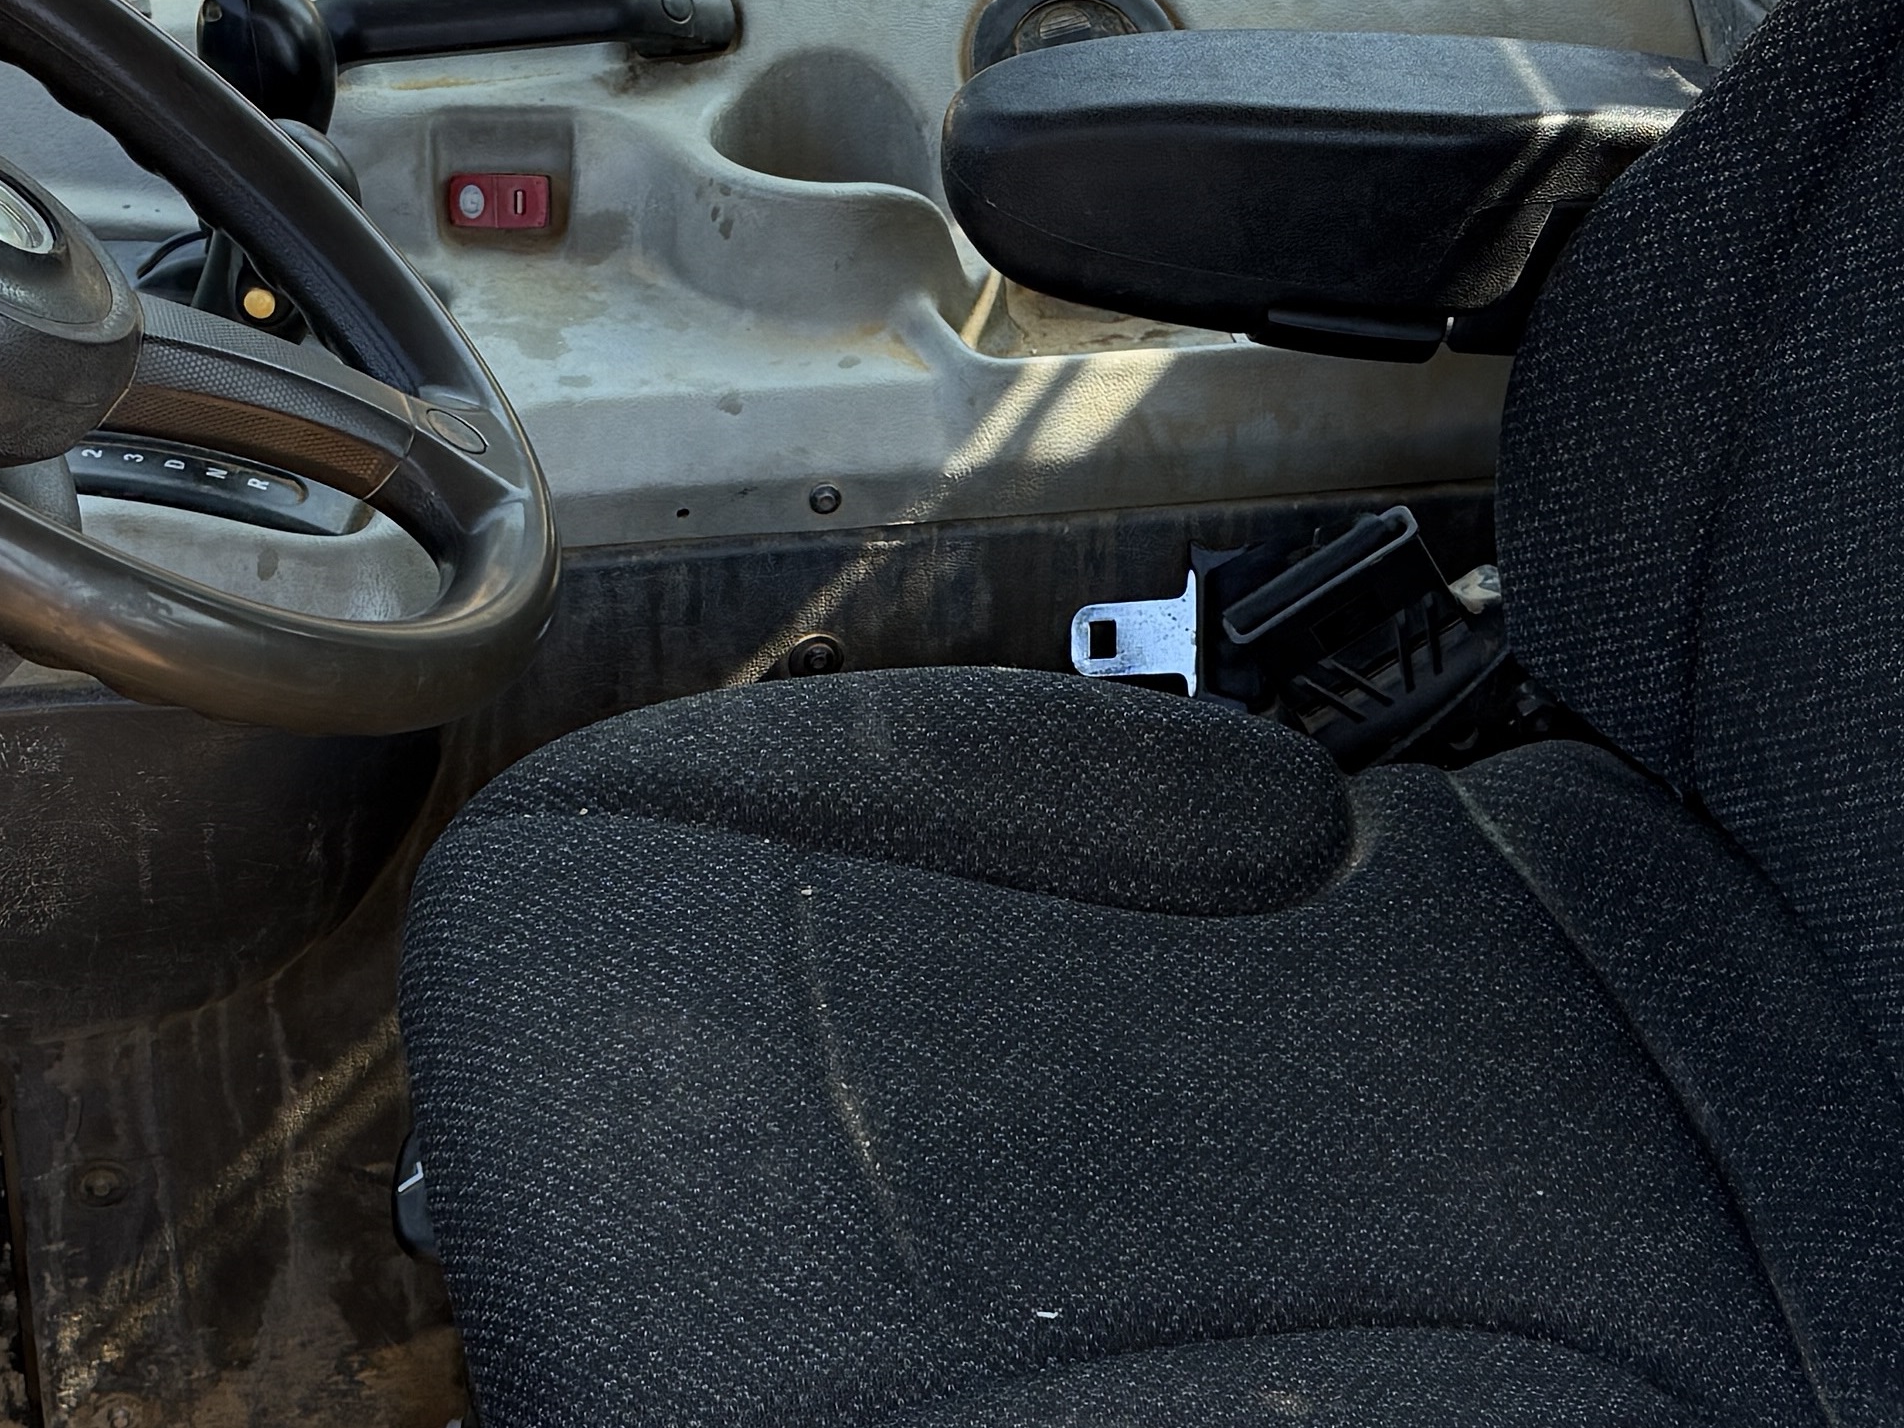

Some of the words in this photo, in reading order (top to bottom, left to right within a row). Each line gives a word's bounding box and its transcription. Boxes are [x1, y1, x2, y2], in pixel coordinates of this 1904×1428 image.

[81, 448, 103, 460] 2
[123, 453, 145, 463] 3
[163, 459, 186, 471] D
[205, 467, 229, 480] N
[246, 477, 270, 491] R
